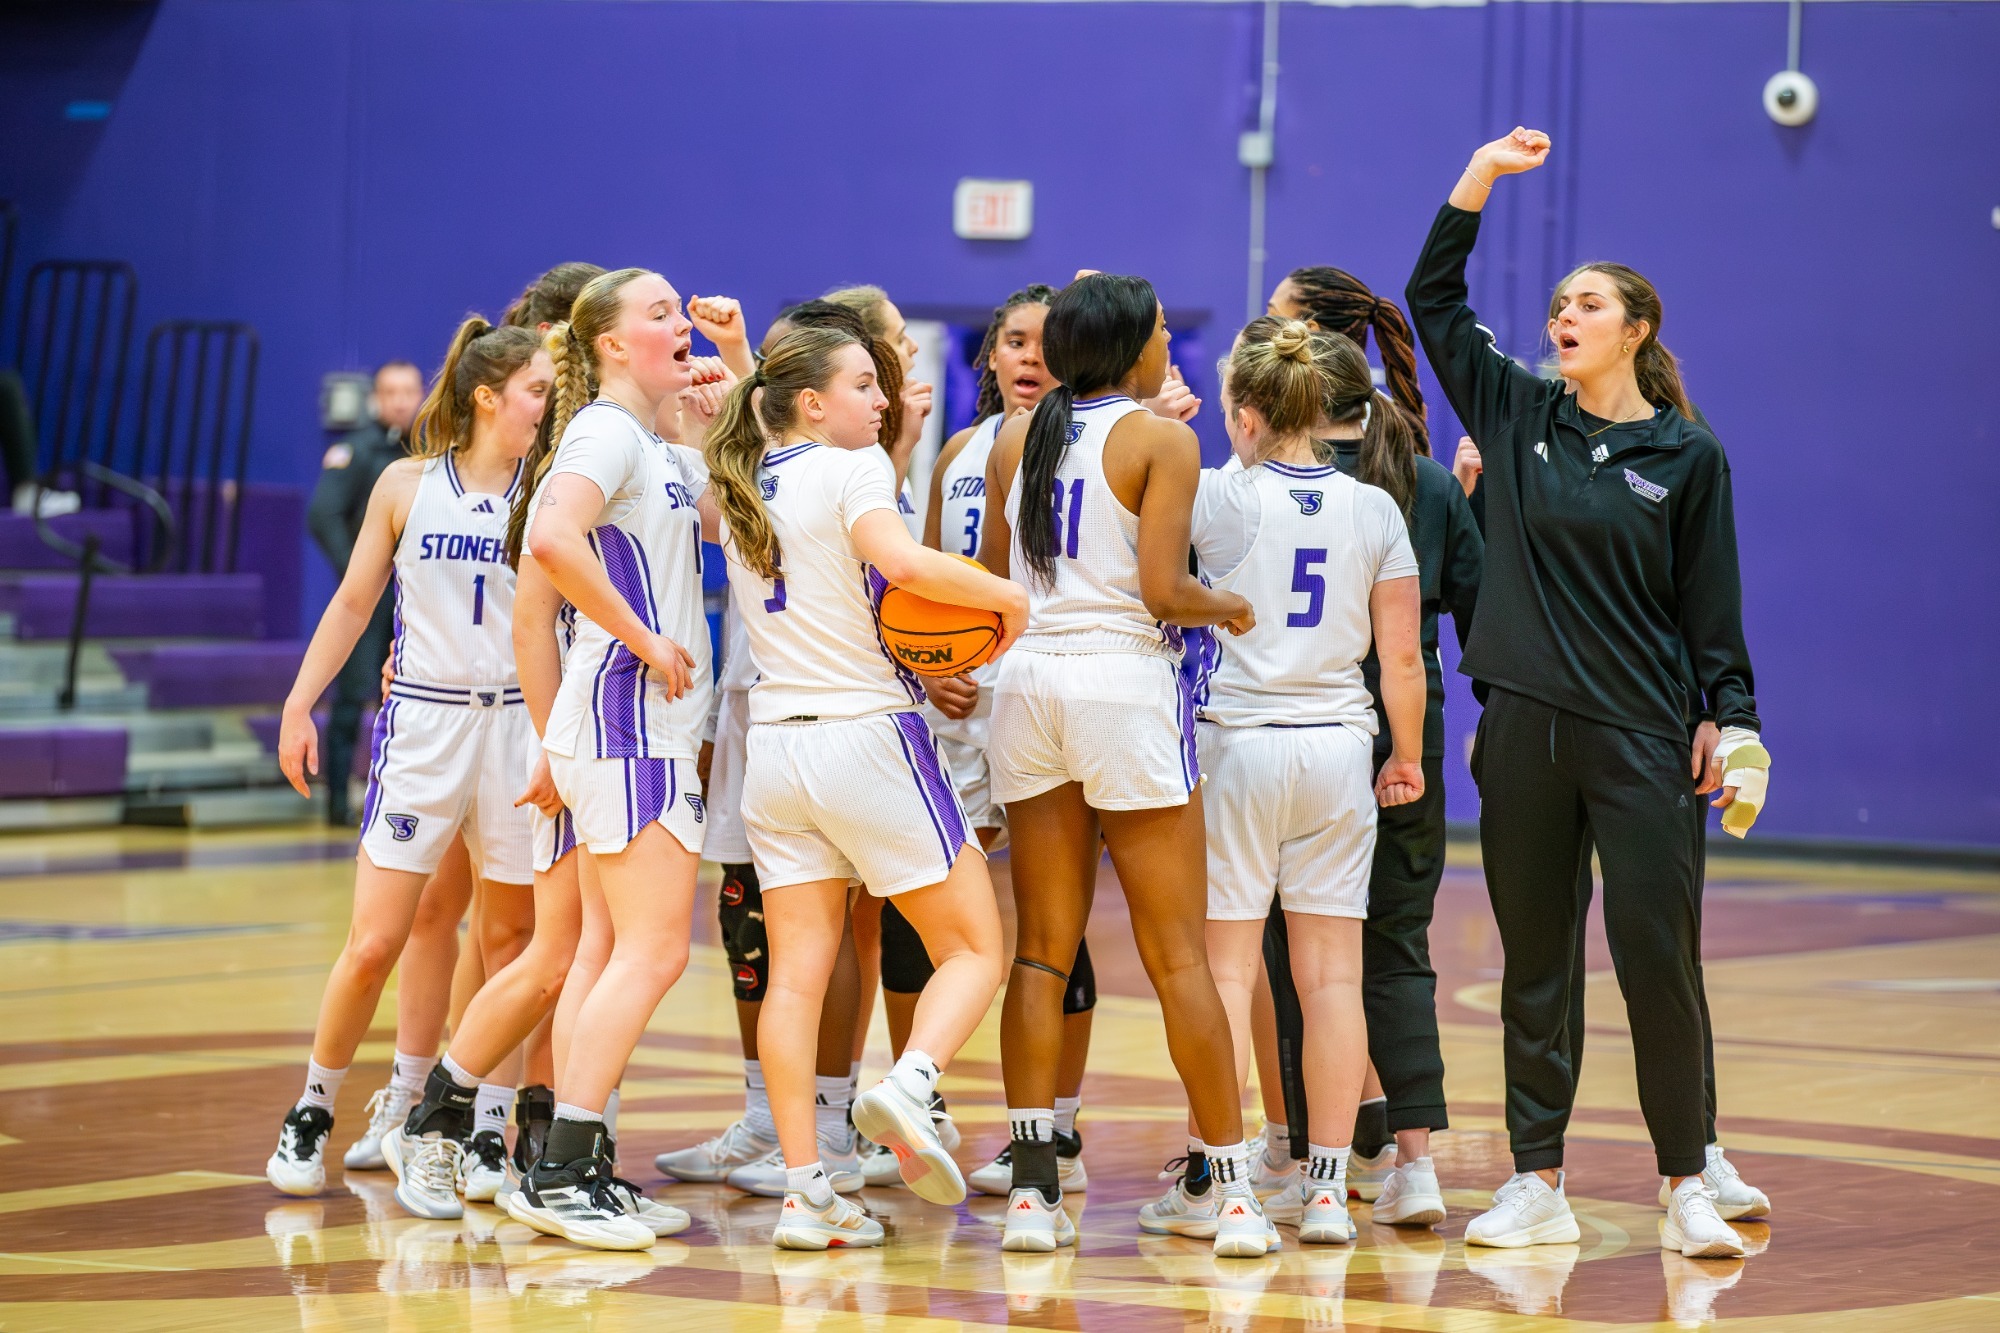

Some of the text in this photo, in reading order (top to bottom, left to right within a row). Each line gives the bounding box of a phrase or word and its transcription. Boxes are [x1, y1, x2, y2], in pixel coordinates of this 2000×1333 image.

[967, 193, 1018, 227] EXIT
[962, 507, 980, 558] 3
[473, 574, 486, 625] 1
[1286, 548, 1328, 627] 5
[895, 643, 953, 664] NCAA
